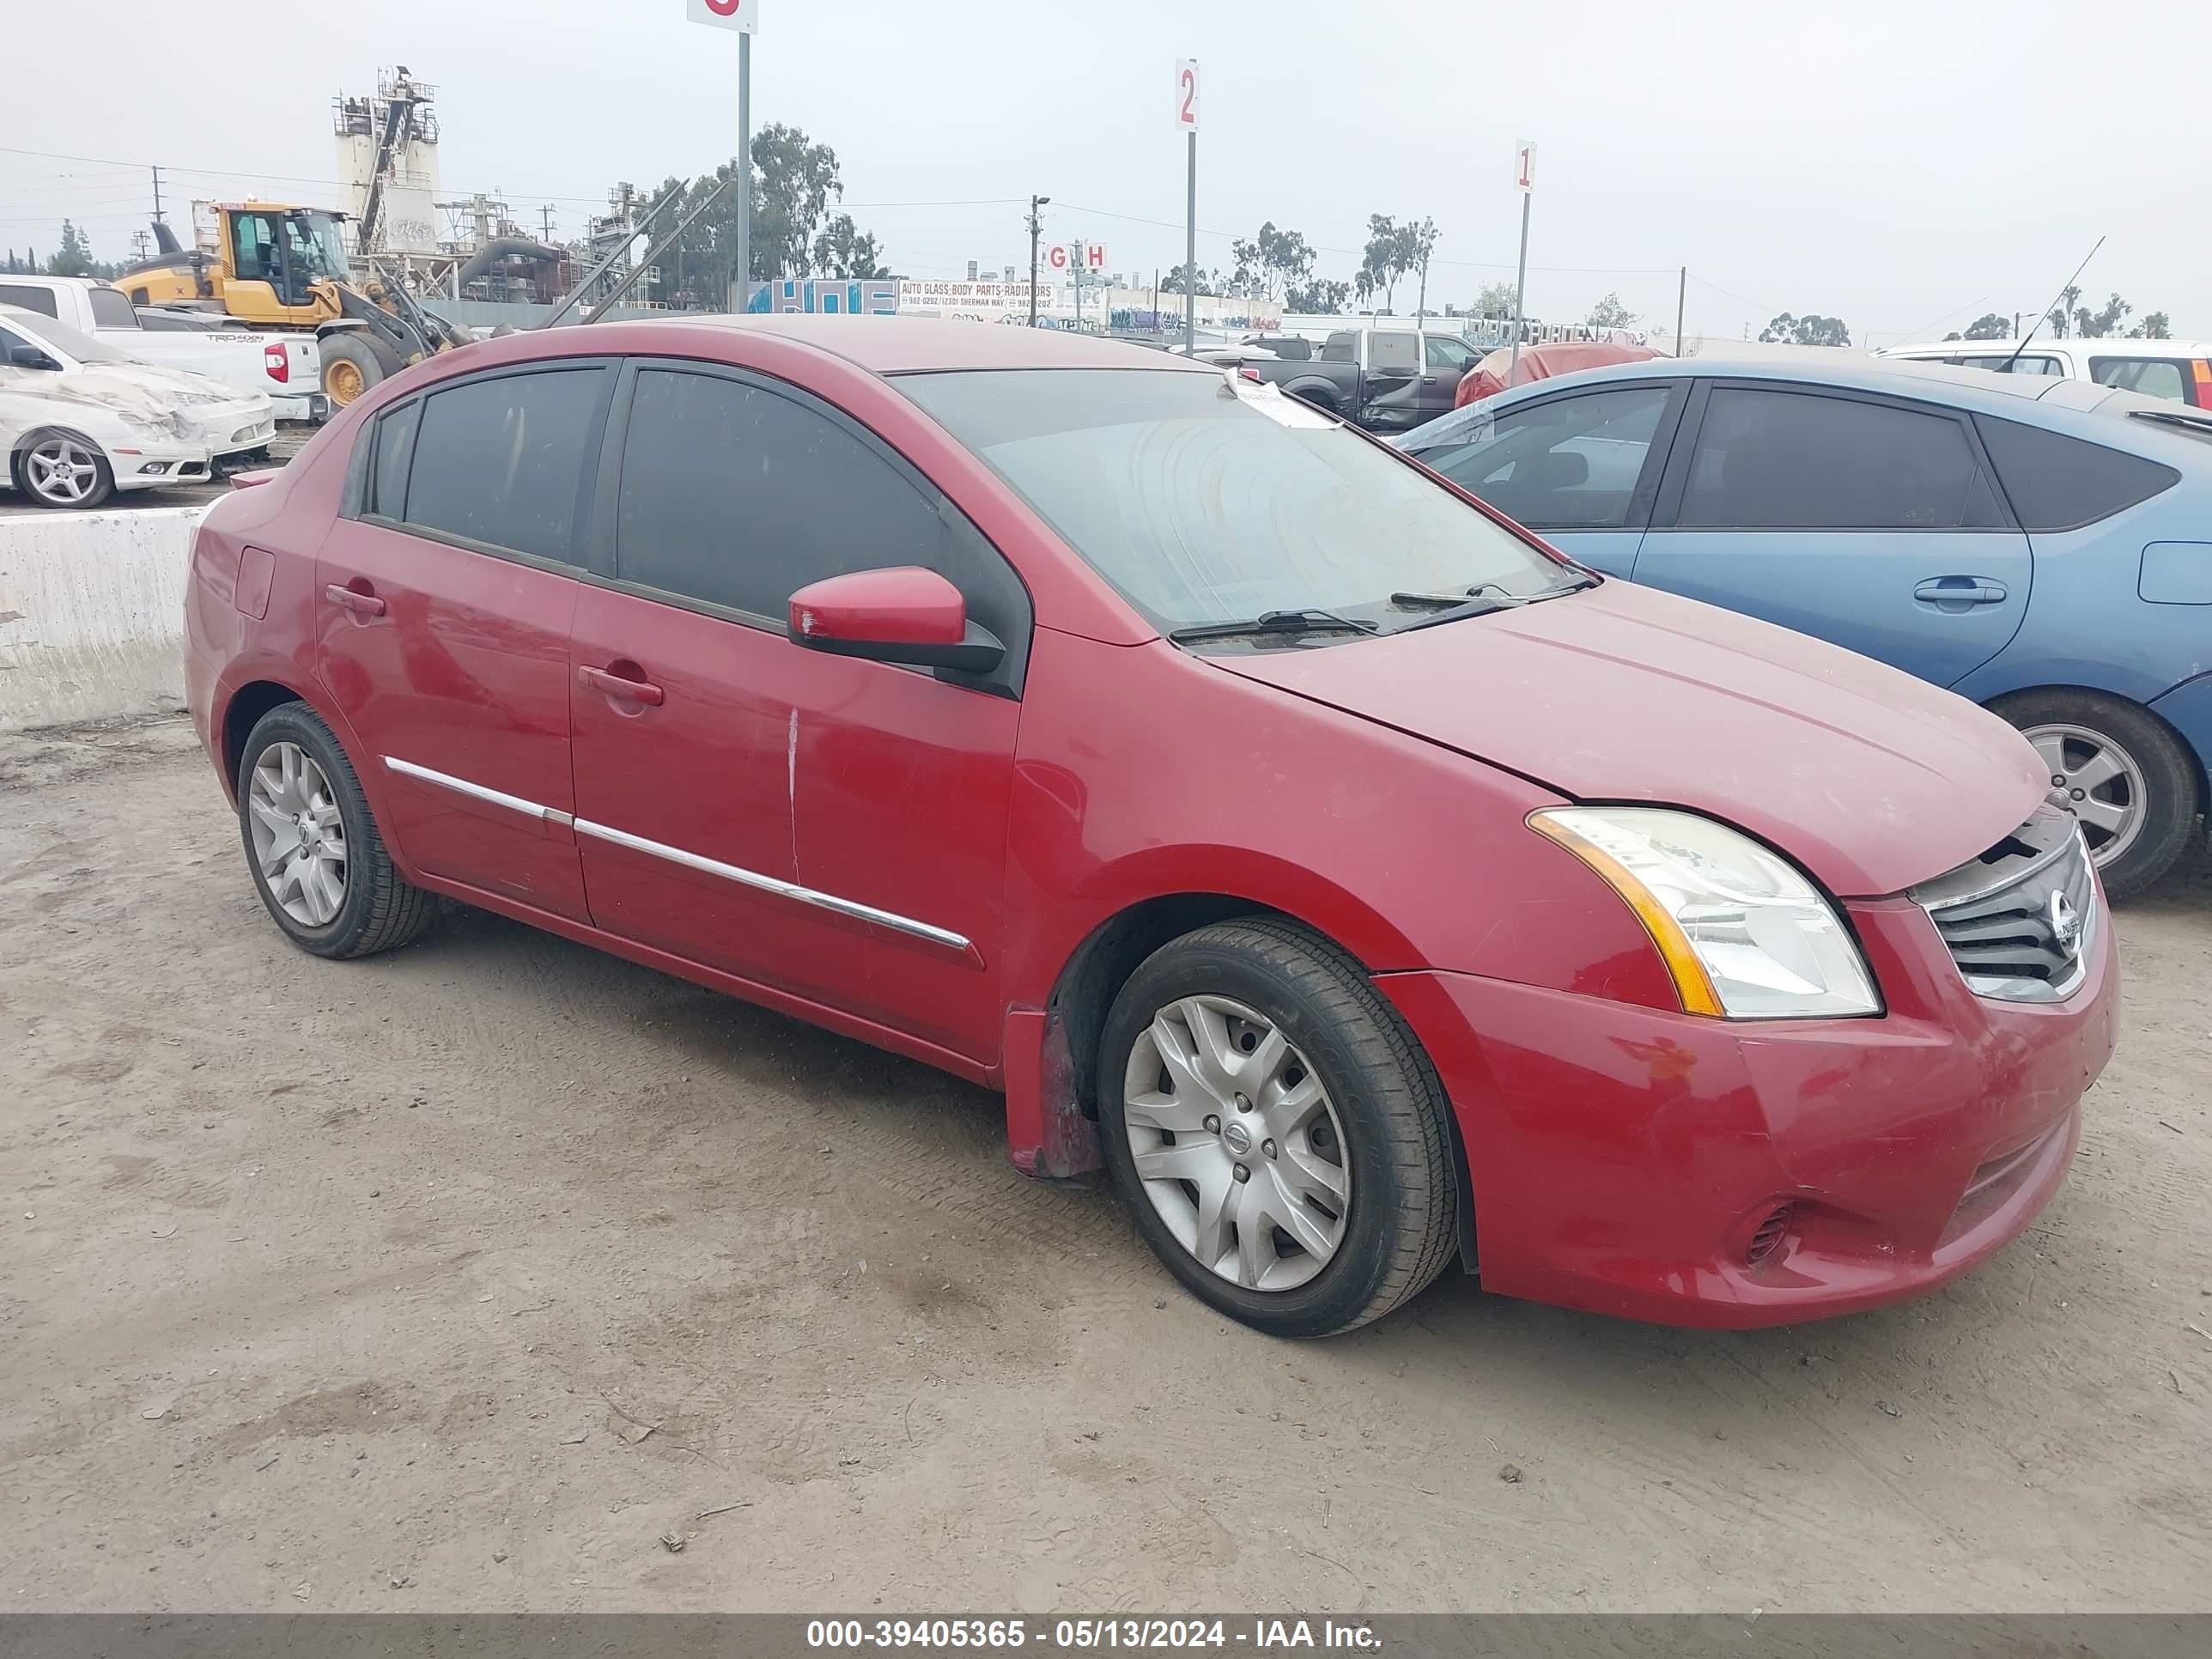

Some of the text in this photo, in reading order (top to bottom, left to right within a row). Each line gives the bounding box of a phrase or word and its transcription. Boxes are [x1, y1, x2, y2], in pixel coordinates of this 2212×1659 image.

[1182, 69, 1194, 124] 2
[1519, 148, 1530, 186] 1
[1050, 246, 1066, 268] G
[1089, 246, 1103, 266] H
[902, 283, 922, 295] AUTO
[960, 297, 989, 307] SHERMAN
